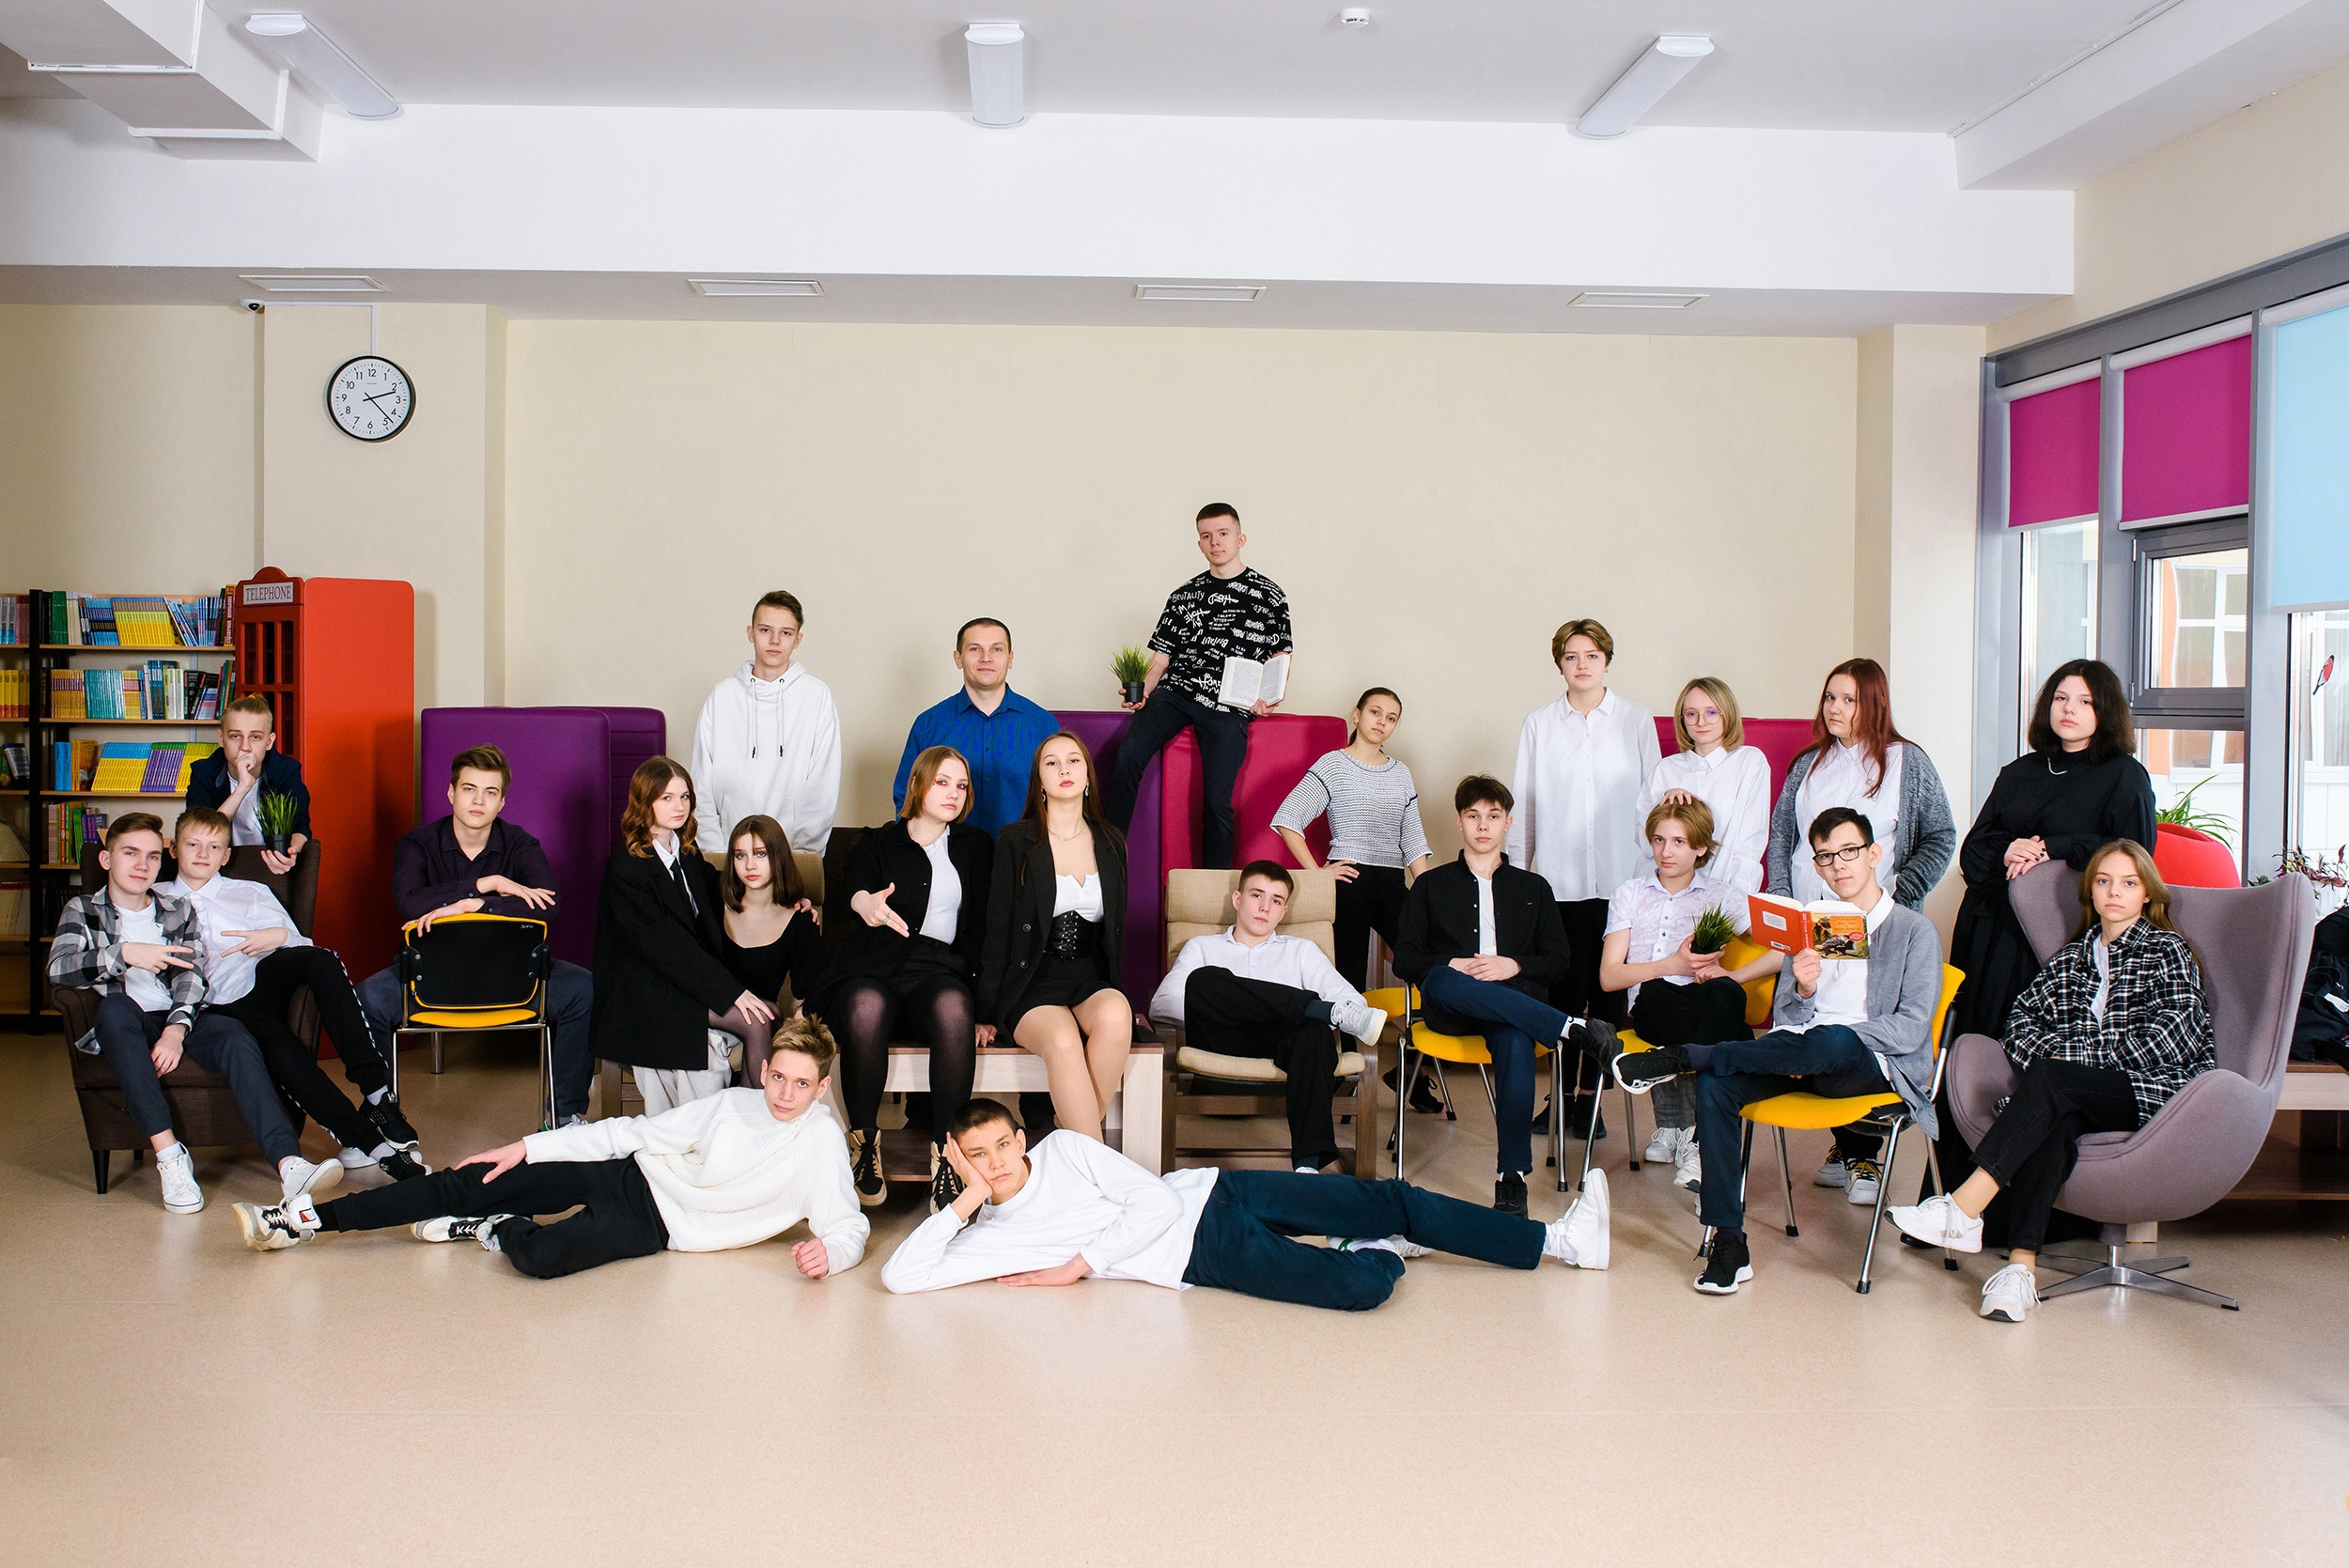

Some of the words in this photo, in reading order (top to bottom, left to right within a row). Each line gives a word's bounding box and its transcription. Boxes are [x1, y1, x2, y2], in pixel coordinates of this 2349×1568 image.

[355, 371, 363, 380] 11
[367, 368, 377, 378] 12
[383, 372, 387, 380] 1
[346, 380, 355, 390] 10
[391, 382, 397, 392] 2
[341, 393, 348, 402] 9
[395, 396, 401, 405] 3
[345, 406, 351, 414] 8
[391, 408, 397, 416] 4
[353, 415, 360, 425] 7
[382, 417, 389, 427] 5
[366, 421, 373, 429] 6
[245, 585, 291, 601] TELEPHONE
[1172, 590, 1206, 603] BRUTALITY
